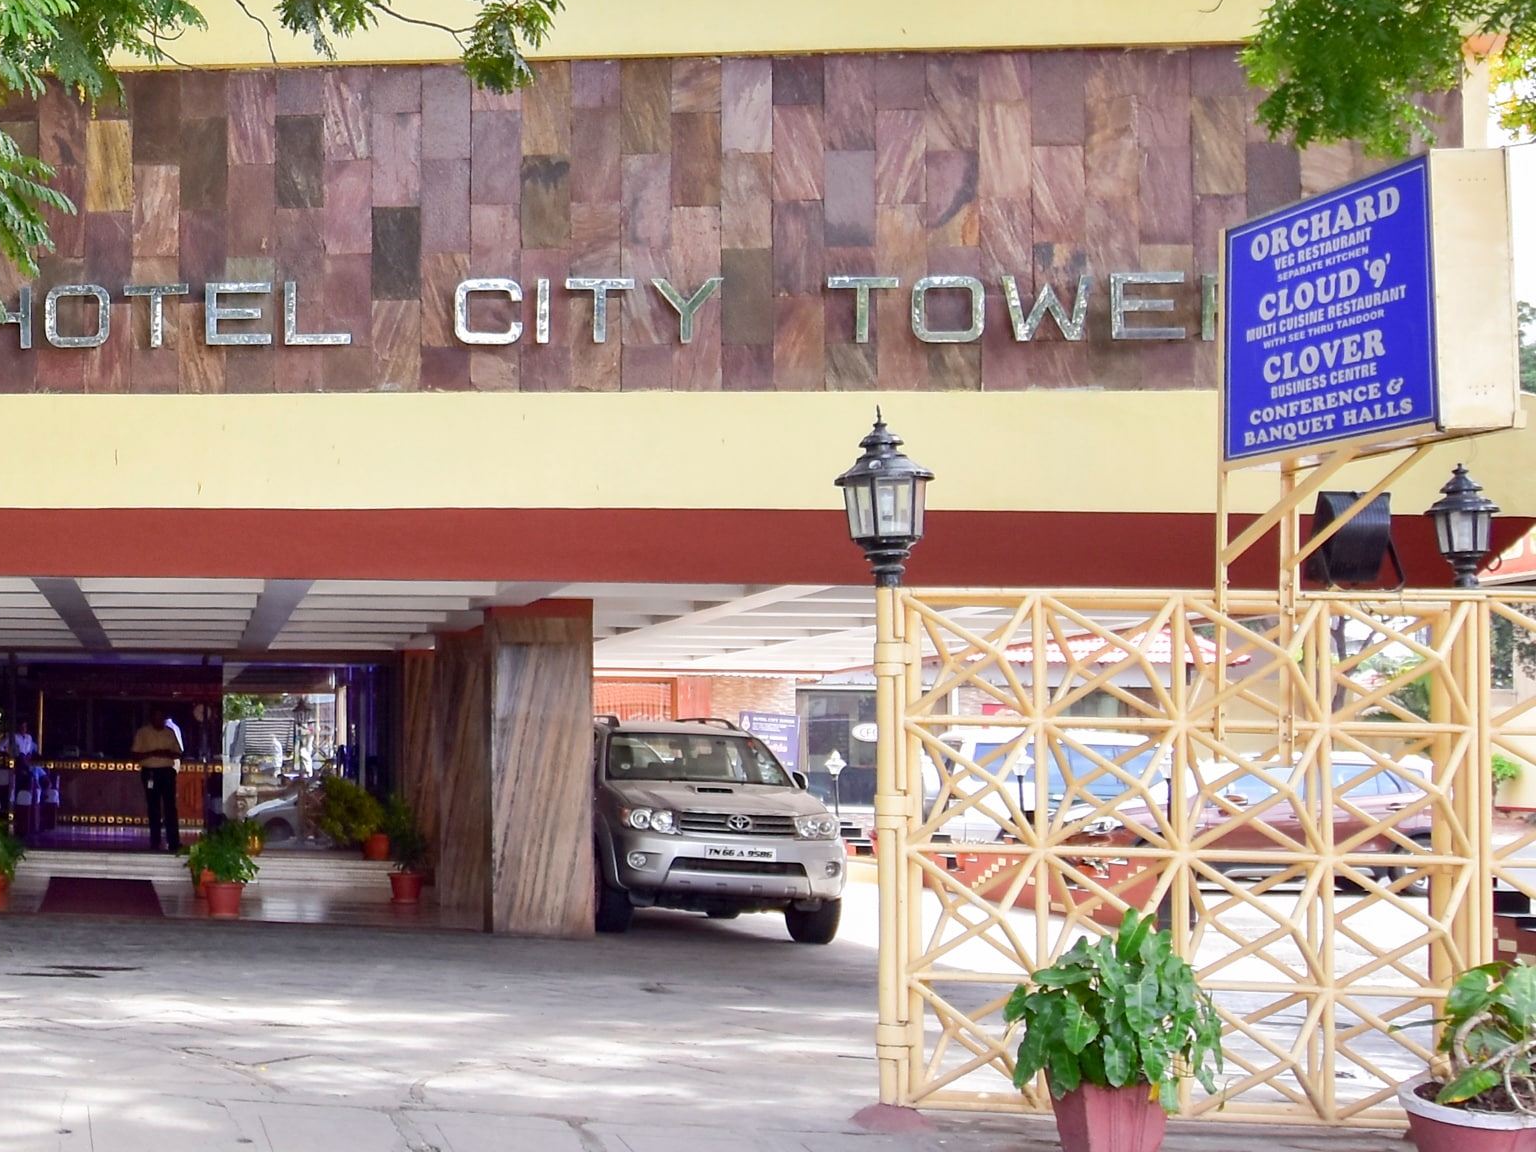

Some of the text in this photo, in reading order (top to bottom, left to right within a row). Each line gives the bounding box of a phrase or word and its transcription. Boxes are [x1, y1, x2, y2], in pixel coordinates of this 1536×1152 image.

[1250, 186, 1400, 262] ORCHARD
[1274, 226, 1372, 271] VEG RESTAURANT
[1277, 245, 1369, 283] SEPARATE KITCHEN
[454, 276, 724, 345] CITY
[1246, 284, 1407, 343] MULTI CUISINE RESTAURANT
[1258, 267, 1360, 321] CLOUD
[1263, 309, 1385, 349] WITH SEE THRU TANDOOR
[1263, 329, 1386, 384] CLOVER
[1249, 377, 1404, 425] CONFERENCE &
[1270, 362, 1378, 400] BUSINESS CENTRE
[1244, 397, 1413, 446] BANQUET HALLS
[708, 848, 721, 856] TN
